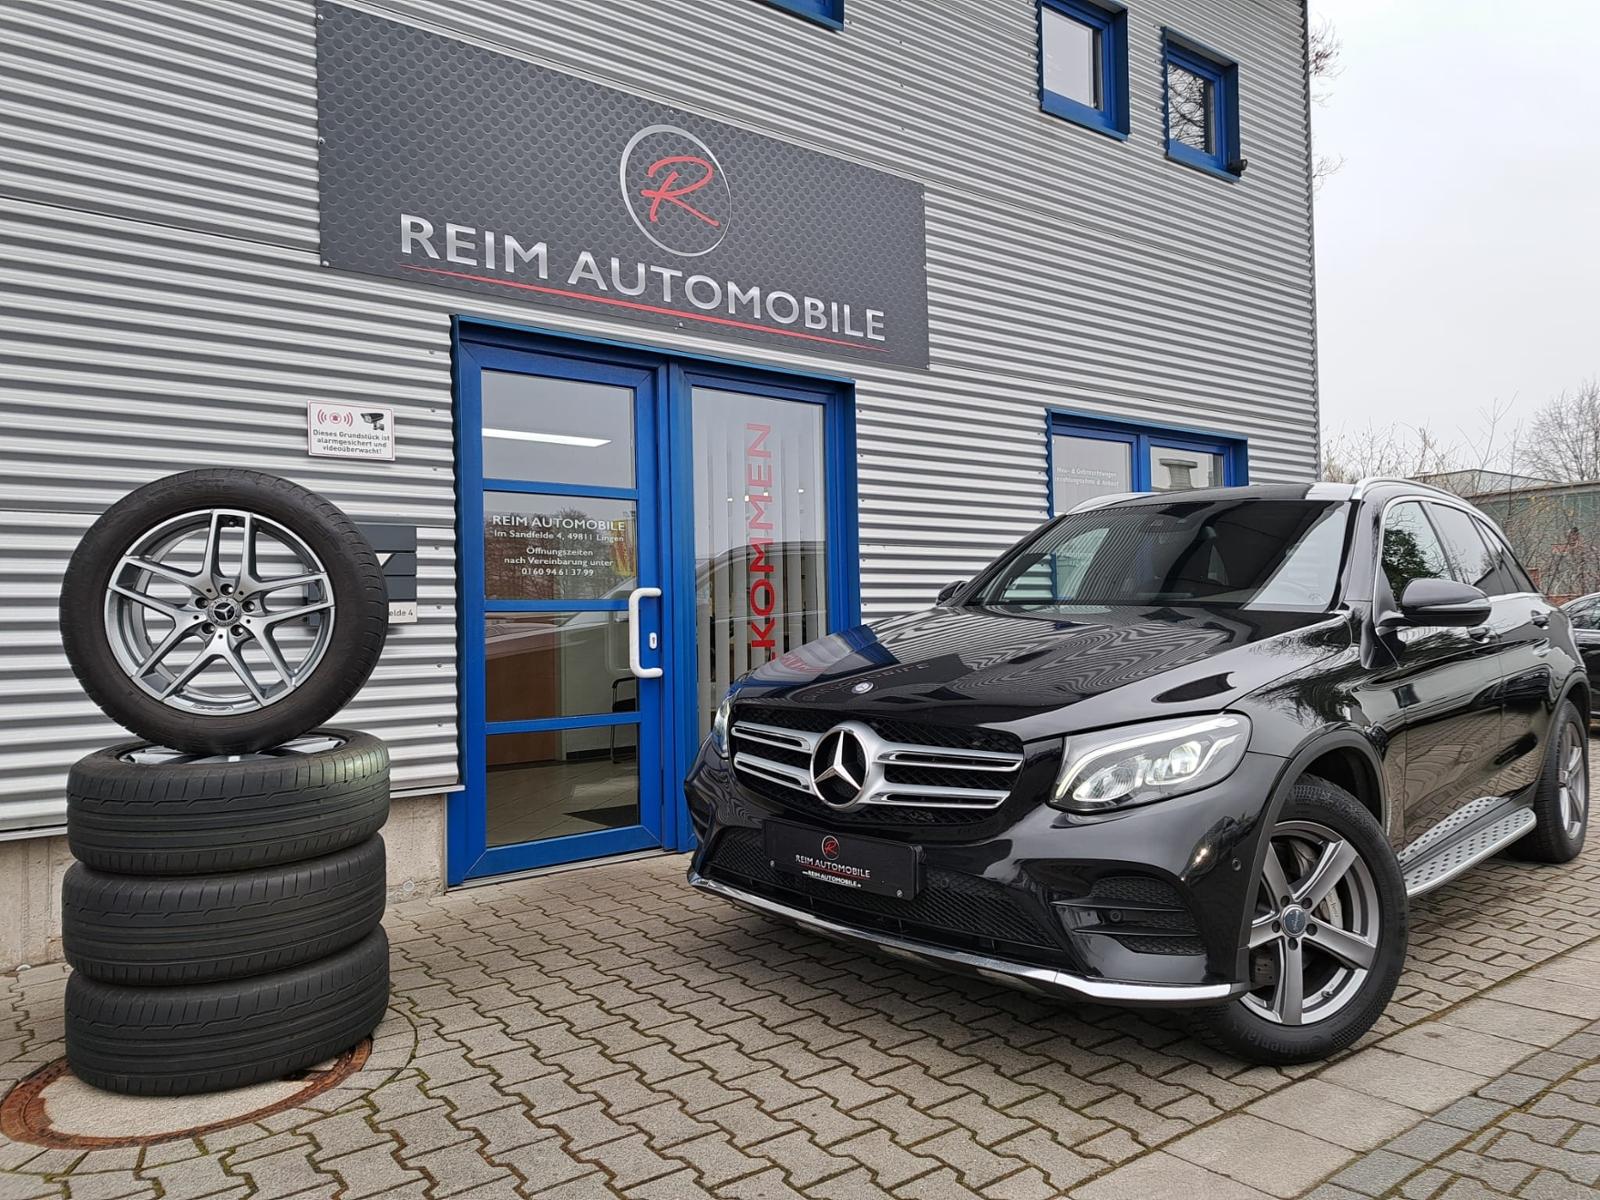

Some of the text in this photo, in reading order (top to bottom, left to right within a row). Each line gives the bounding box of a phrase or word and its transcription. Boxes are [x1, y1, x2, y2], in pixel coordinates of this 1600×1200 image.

[640, 155, 720, 227] R
[400, 213, 886, 341] REIM AUTOMOBILE
[313, 429, 390, 441] Dieses Grundstück ist
[317, 437, 372, 447] alarmgesichert
[492, 515, 625, 531] REIM AUTOMOBILE
[494, 529, 507, 537] Im
[509, 530, 554, 539] Sandfelde
[567, 532, 593, 541] 49811
[596, 534, 624, 543] Lingen
[746, 422, 776, 660] KOMMEN
[526, 546, 594, 557] Öffnungszeiten
[528, 557, 588, 567] Vereinbarung
[521, 567, 544, 576] 0160
[545, 567, 557, 575] 94
[559, 568, 569, 576] 61
[570, 568, 581, 576] 37
[389, 608, 406, 616] elde
[795, 854, 871, 878] REIM AUTOMOBILE
